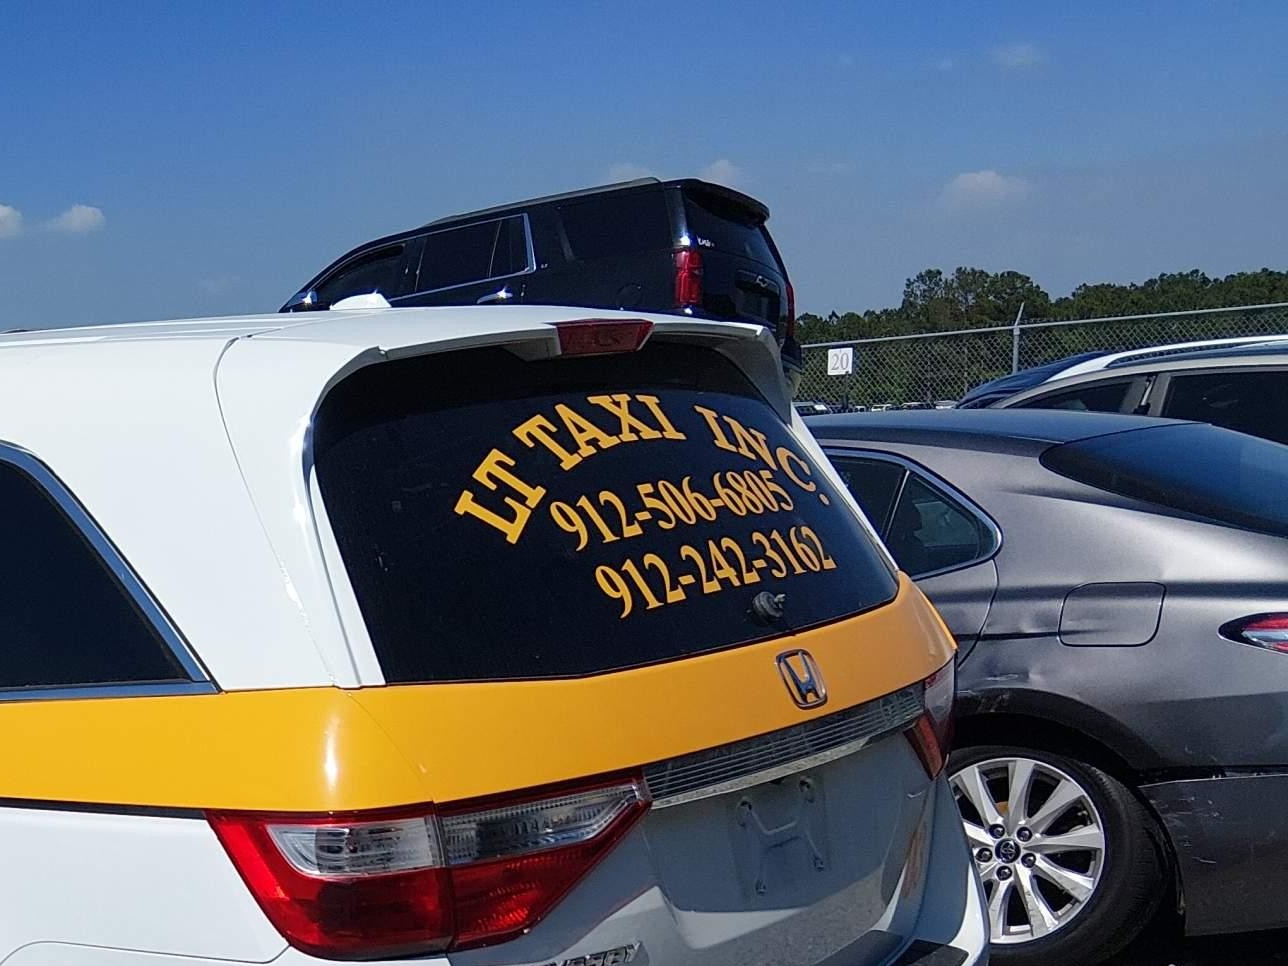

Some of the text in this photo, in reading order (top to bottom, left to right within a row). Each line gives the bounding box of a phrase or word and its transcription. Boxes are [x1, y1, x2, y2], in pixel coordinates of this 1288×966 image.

[830, 352, 850, 371] 20
[454, 393, 830, 545] LT TAXI INC.
[549, 470, 794, 551] 912-506-6805
[595, 525, 837, 620] 912-242-3162
